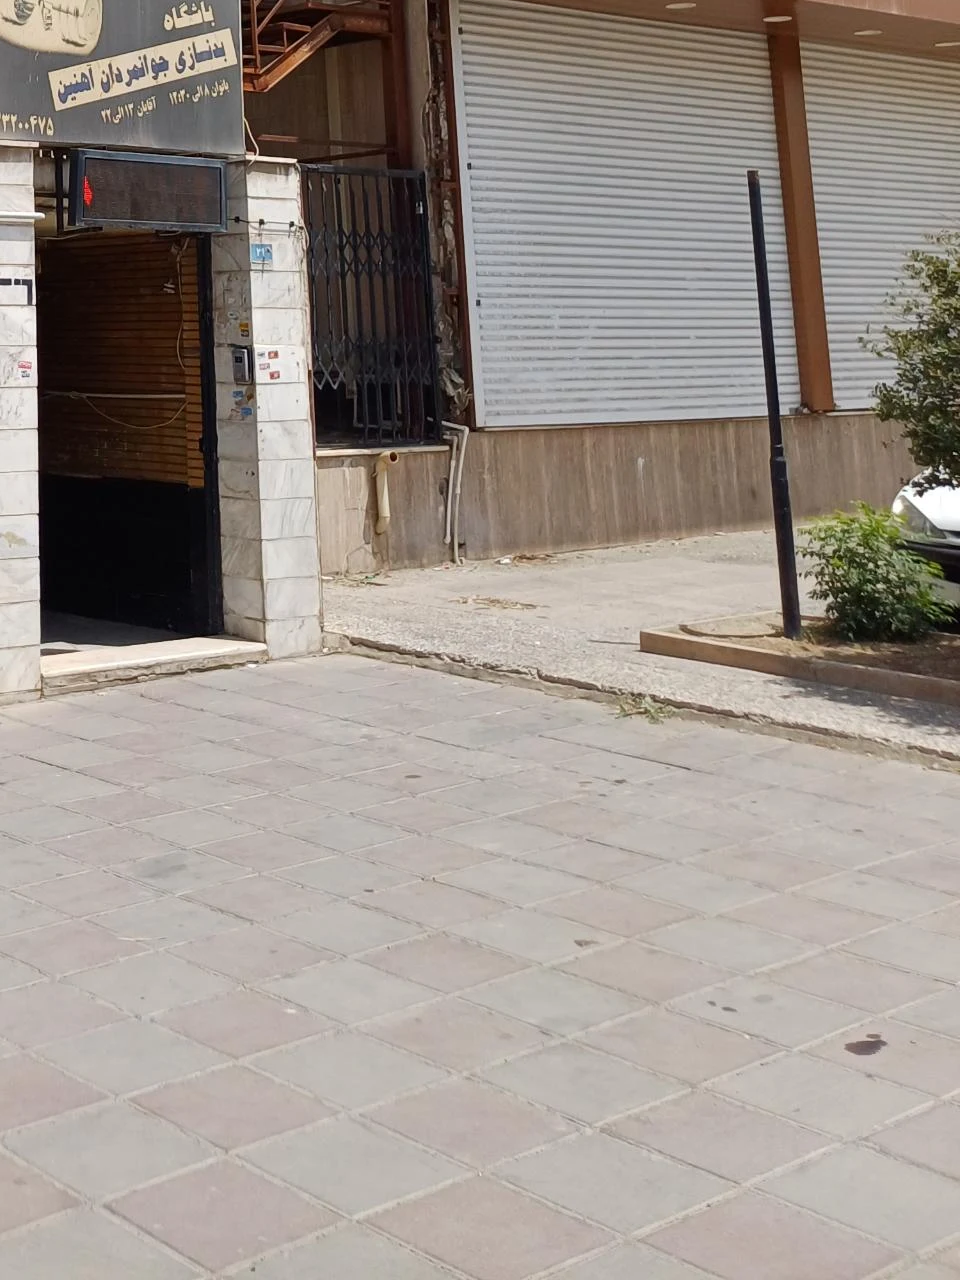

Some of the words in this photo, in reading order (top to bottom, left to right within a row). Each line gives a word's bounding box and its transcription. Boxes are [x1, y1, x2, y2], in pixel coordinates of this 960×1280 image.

[163, 0, 216, 32] باشگاه
[174, 38, 228, 75] بدنسازی
[56, 63, 95, 105] آهنین
[100, 53, 171, 94] جوانمردان
[191, 84, 204, 103] الی
[204, 82, 211, 97] ۸
[210, 78, 231, 98] بانوان
[112, 105, 125, 124] الی
[136, 95, 157, 117] آقایان
